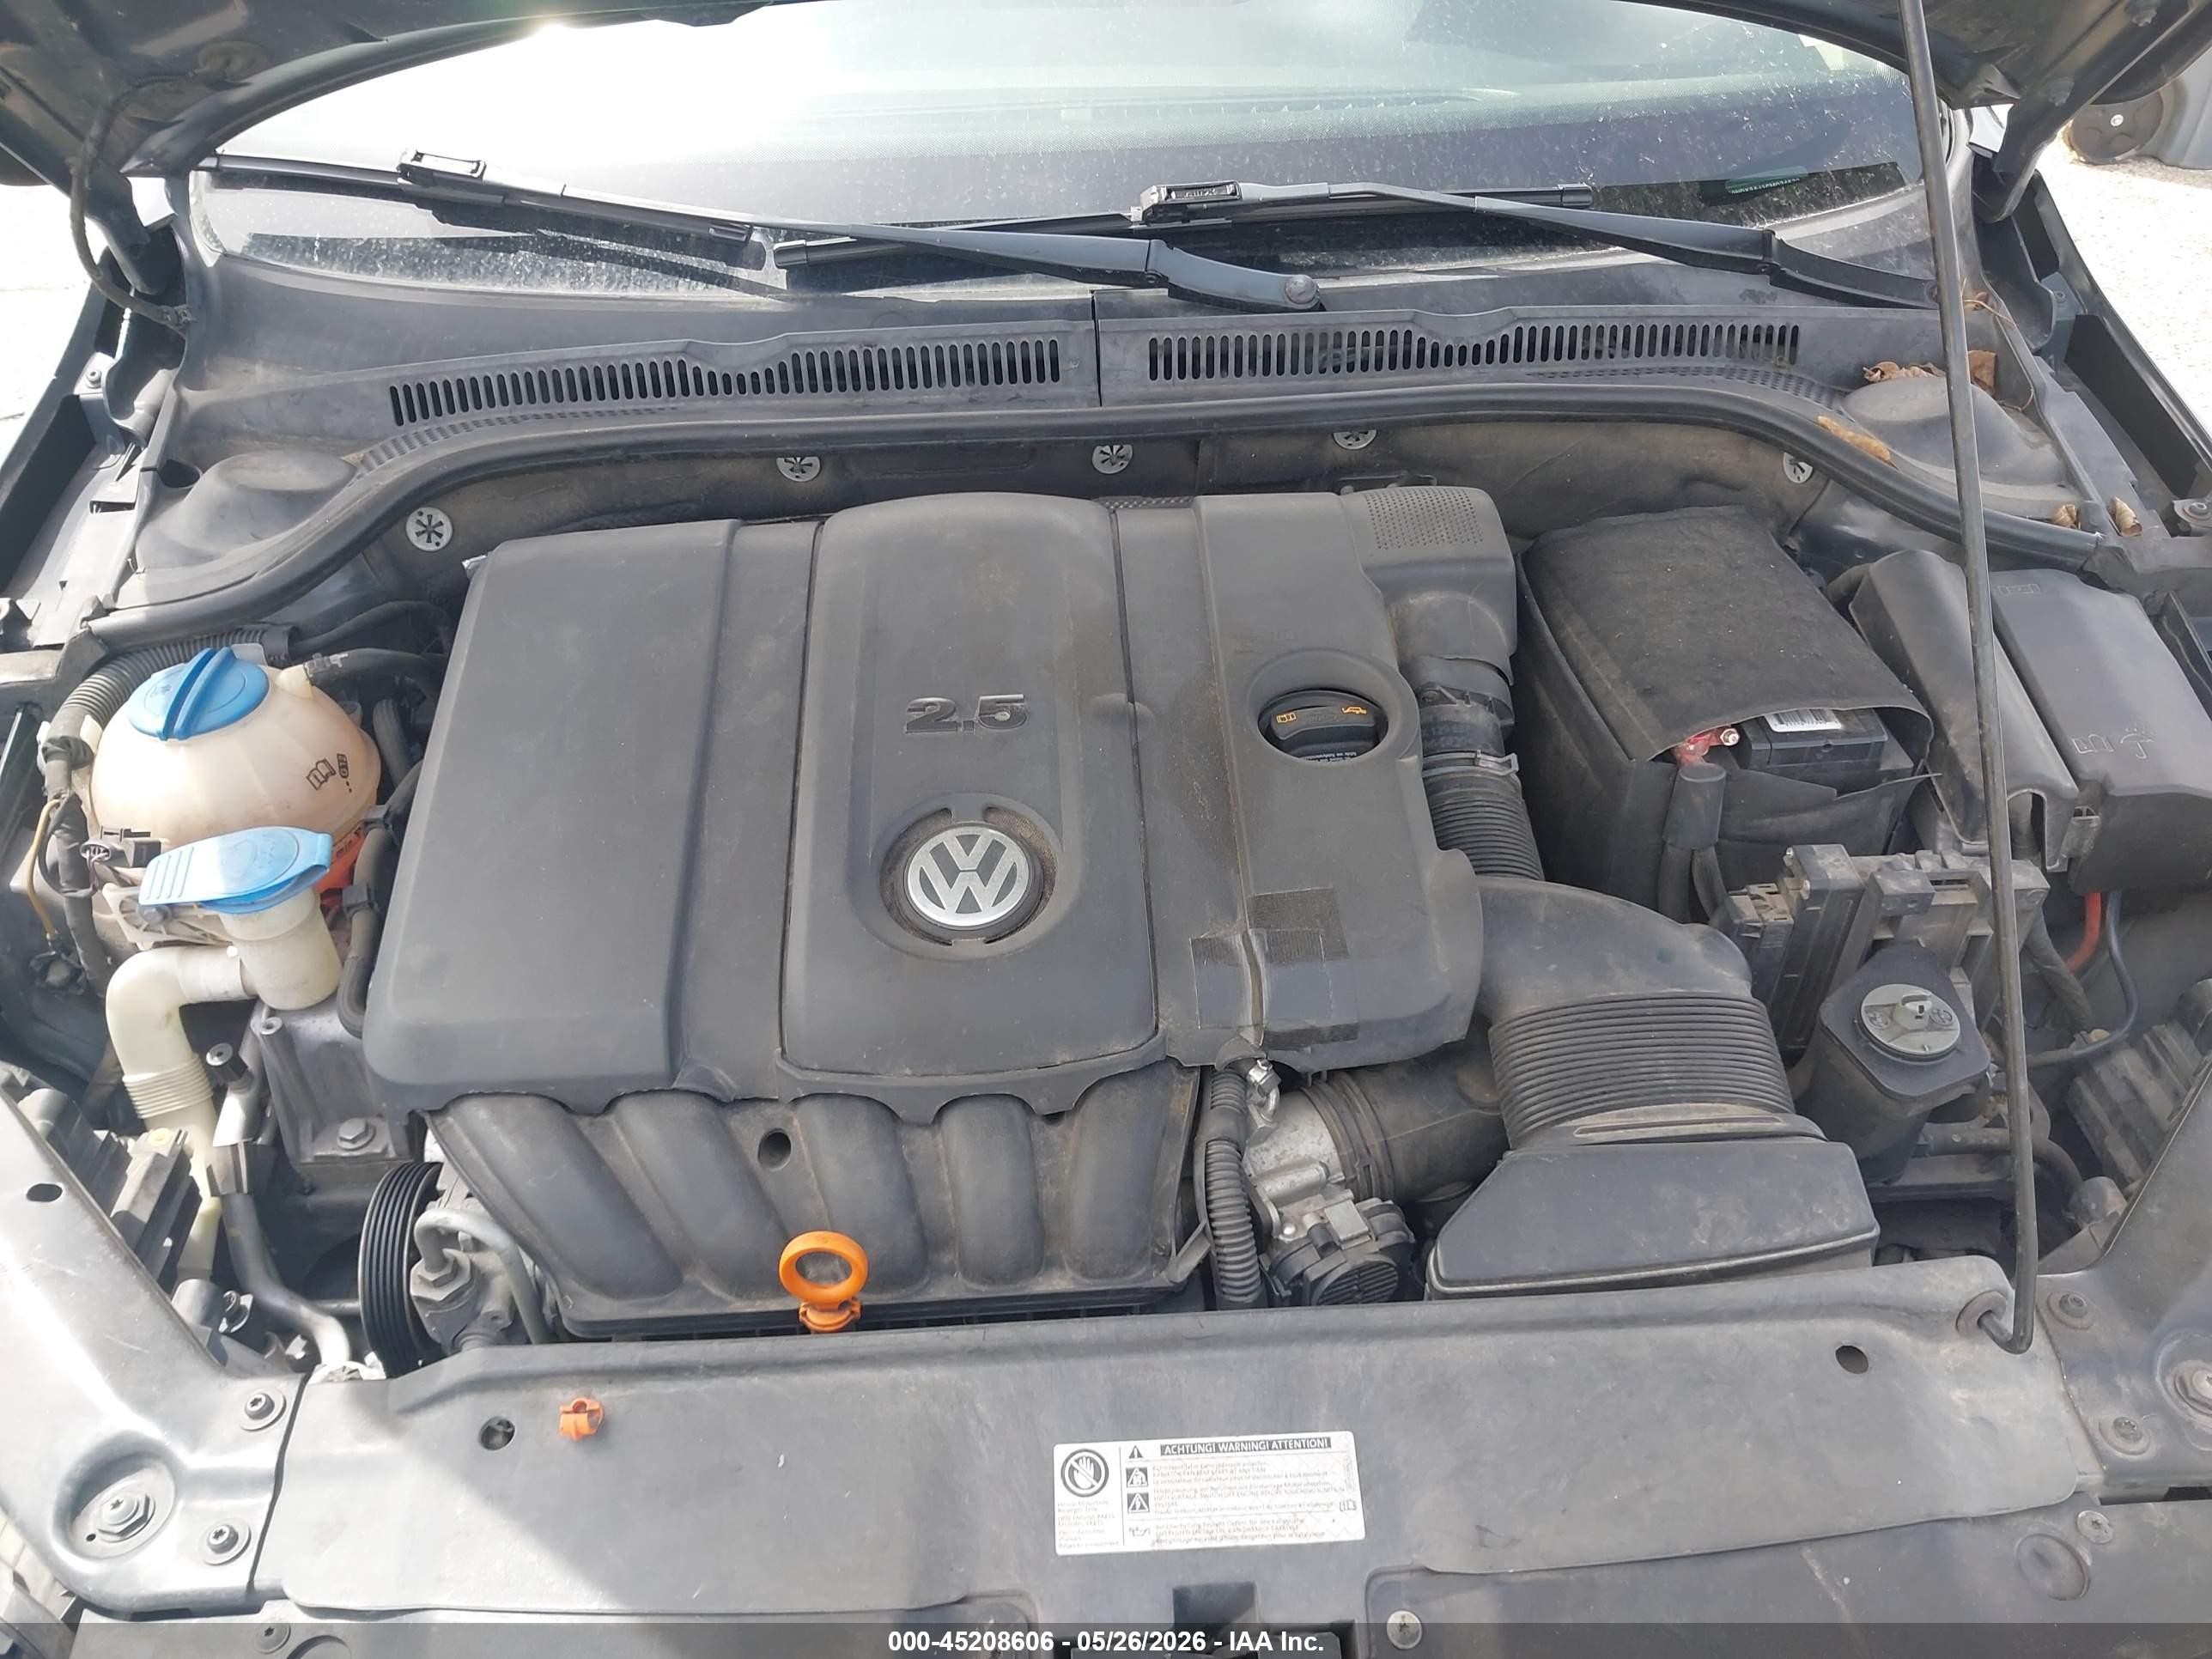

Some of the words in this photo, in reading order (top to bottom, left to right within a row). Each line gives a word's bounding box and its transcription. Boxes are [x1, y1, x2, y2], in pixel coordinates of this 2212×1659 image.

[906, 694, 1028, 734] 2.5
[1164, 1442, 1217, 1455] ACHTUNG!
[1217, 1440, 1269, 1453] WARNING!
[1271, 1437, 1328, 1451] ATTENTION!
